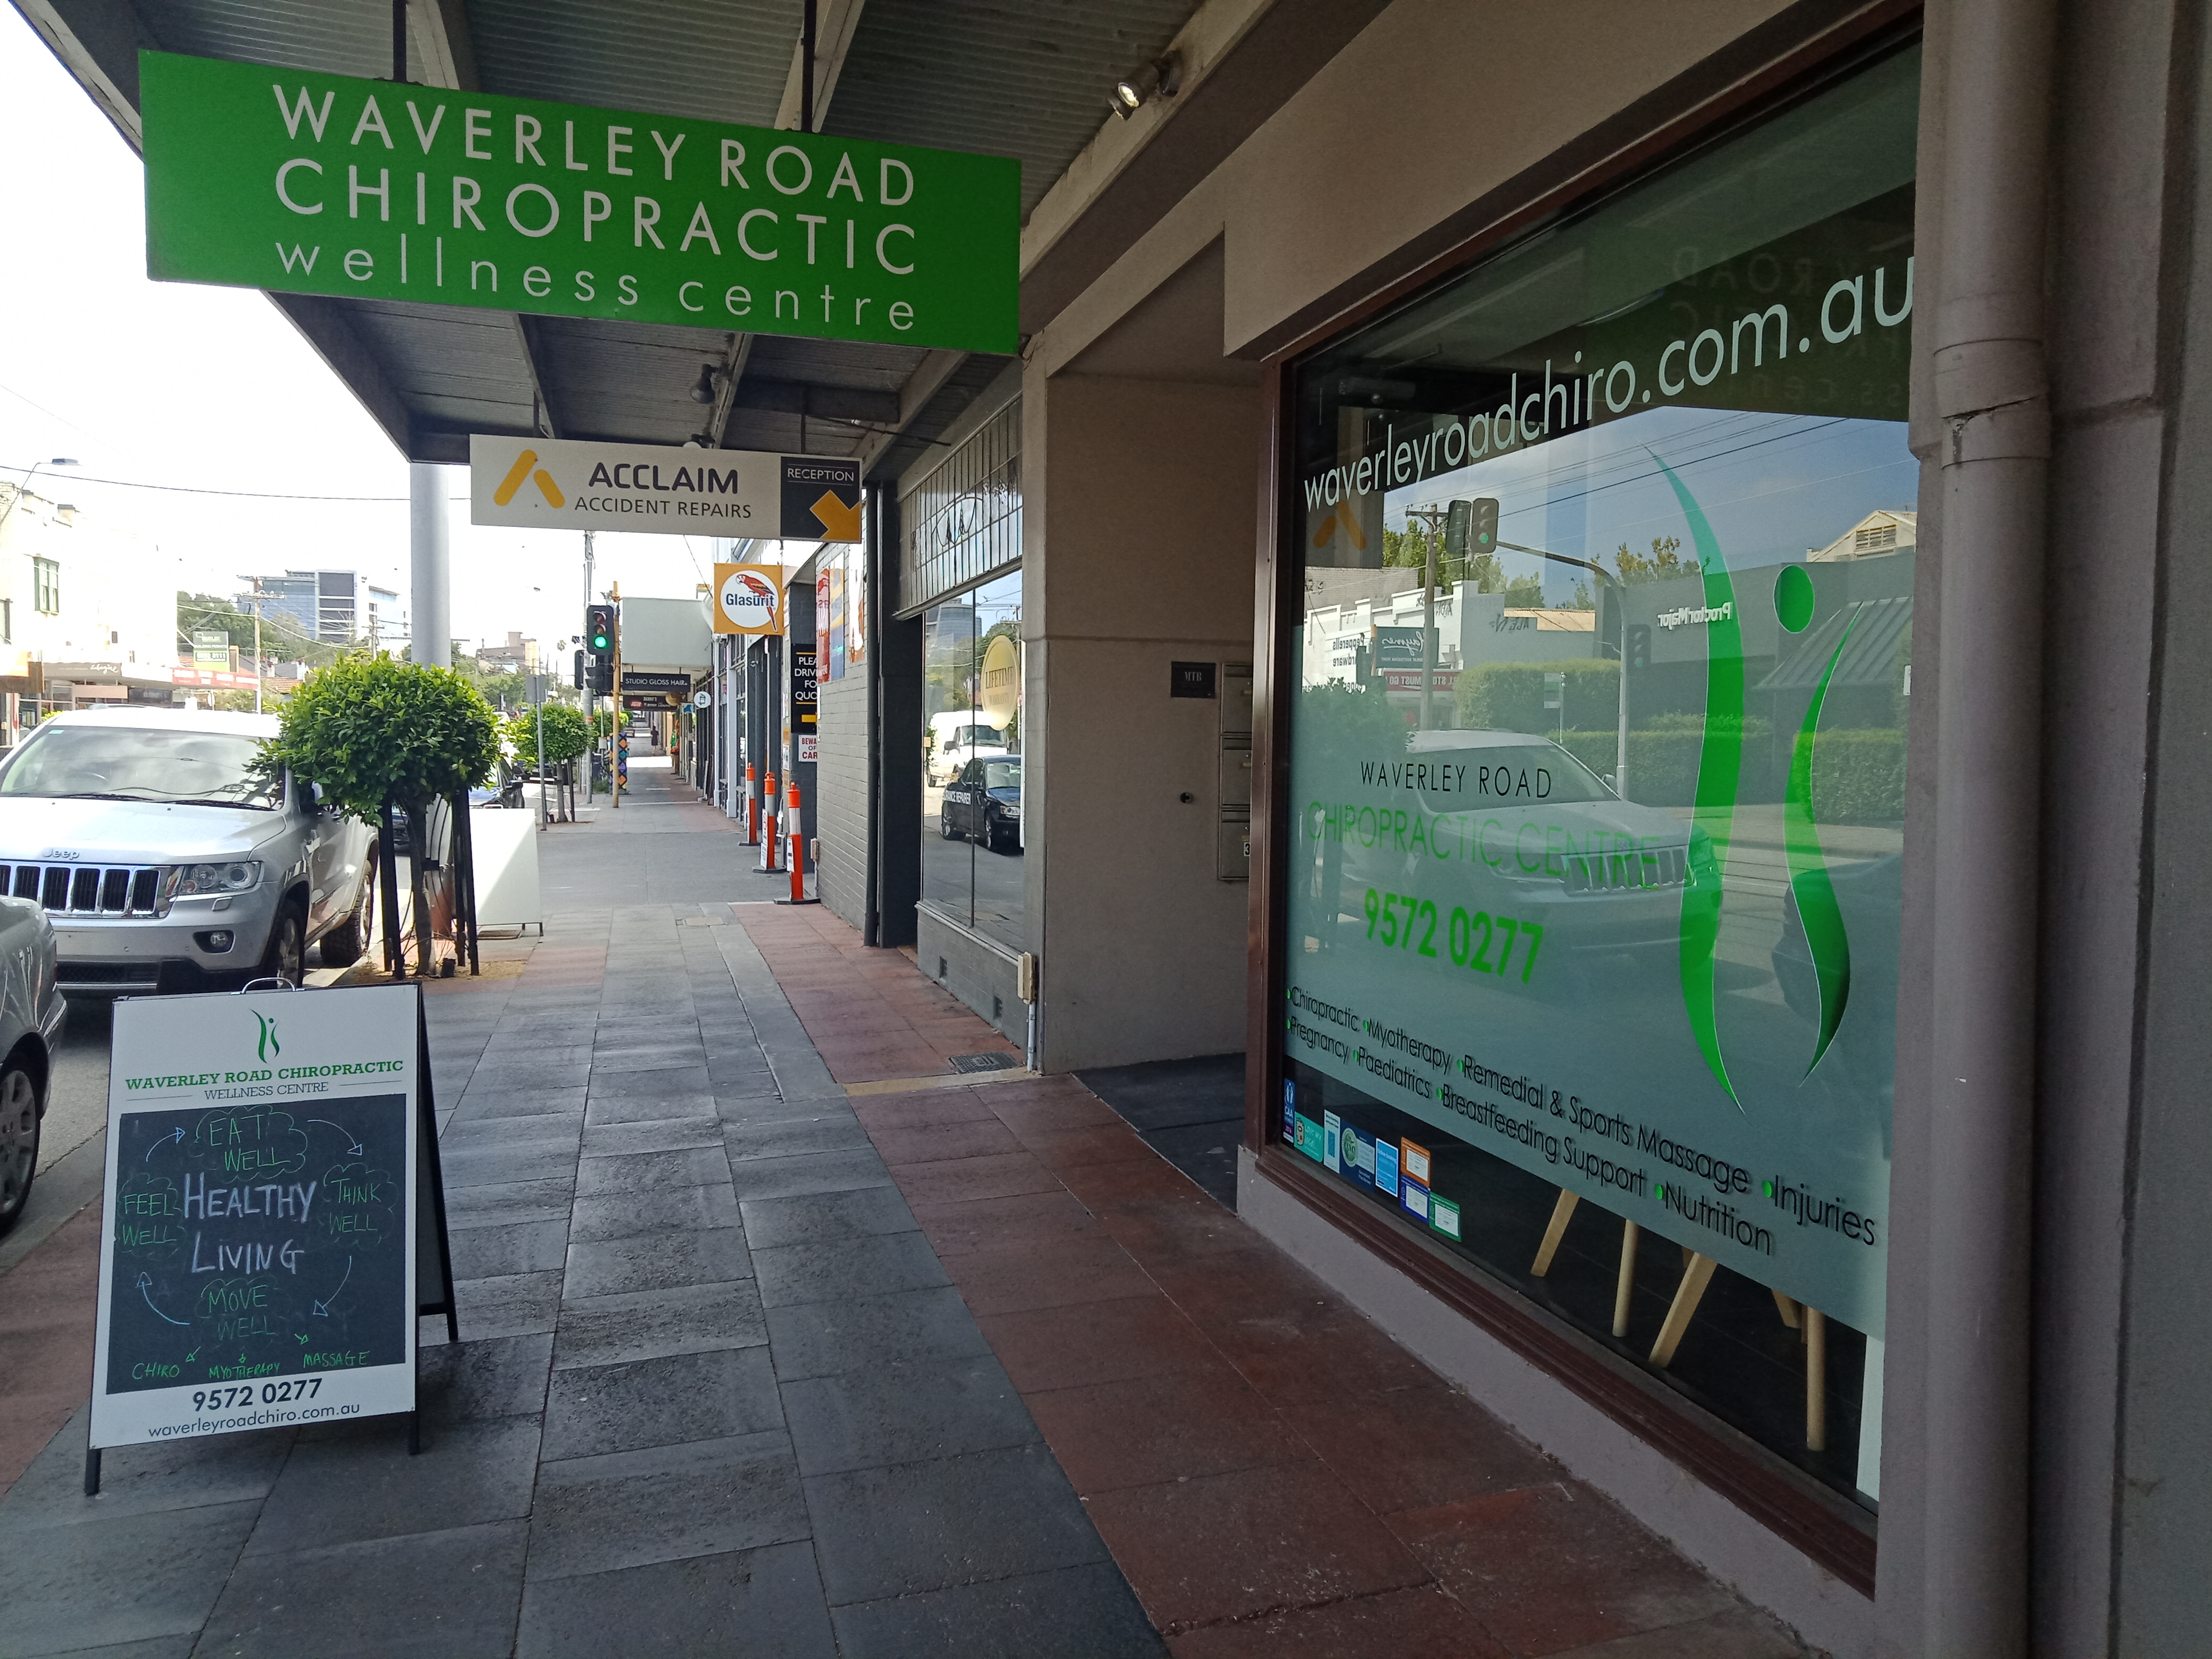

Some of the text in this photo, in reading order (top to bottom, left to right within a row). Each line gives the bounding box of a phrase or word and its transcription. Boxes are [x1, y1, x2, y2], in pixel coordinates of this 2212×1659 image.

[272, 85, 915, 206] WAVERLEY ROAD
[276, 158, 915, 274] CHIROPRACTIC
[275, 234, 915, 330] wellness centre
[1304, 256, 1914, 513] waverleyroadchiro.com.au
[588, 462, 739, 494] ACCLAIM
[787, 467, 854, 482] RECEPTION
[574, 497, 751, 519] ACCIDENT REPAIRS
[726, 593, 774, 607] Glasurit
[799, 657, 817, 665] PLEA
[805, 680, 817, 688] FO
[985, 666, 1013, 689] LIFETIME
[795, 691, 817, 701] QUO
[1361, 761, 1552, 799] WAVERLEY ROAD
[43, 848, 80, 860] Jeep
[1245, 843, 1250, 855] 3
[1307, 801, 1660, 891] CHIROPRACTIC CENTRE
[1364, 888, 1544, 984] 9572 0277
[125, 1060, 404, 1090] WAVERLEY ROAD CHIROPRACTIC
[205, 1082, 328, 1100] WELLNESS CENTRE
[210, 1114, 265, 1146] EAT
[1292, 986, 1875, 1246] Chiropractic Myotherapy Remedial & Sports Massage Injuries
[1291, 1016, 1350, 1065] Pregnancy
[1359, 1046, 1431, 1100] Paediatrics
[1443, 1083, 1558, 1163] Breastfeeding
[1563, 1136, 1644, 1197] Support
[1666, 1181, 1770, 1255] Nutrition
[224, 1147, 291, 1171] WELL
[124, 1193, 175, 1216] FEEL
[183, 1171, 317, 1223] HEALTHY
[331, 1178, 381, 1205] THINK
[122, 1224, 177, 1246] WELL
[329, 1213, 378, 1235] WELL
[191, 1231, 305, 1274] LIVING
[208, 1284, 268, 1313] MOVE
[217, 1316, 276, 1341] WELL
[132, 1350, 371, 1380] CHIRO MYOTHERAPY MASSAGE
[192, 1378, 323, 1412] 9572 0277
[148, 1402, 361, 1438] waverleyroadchiro.com.au
